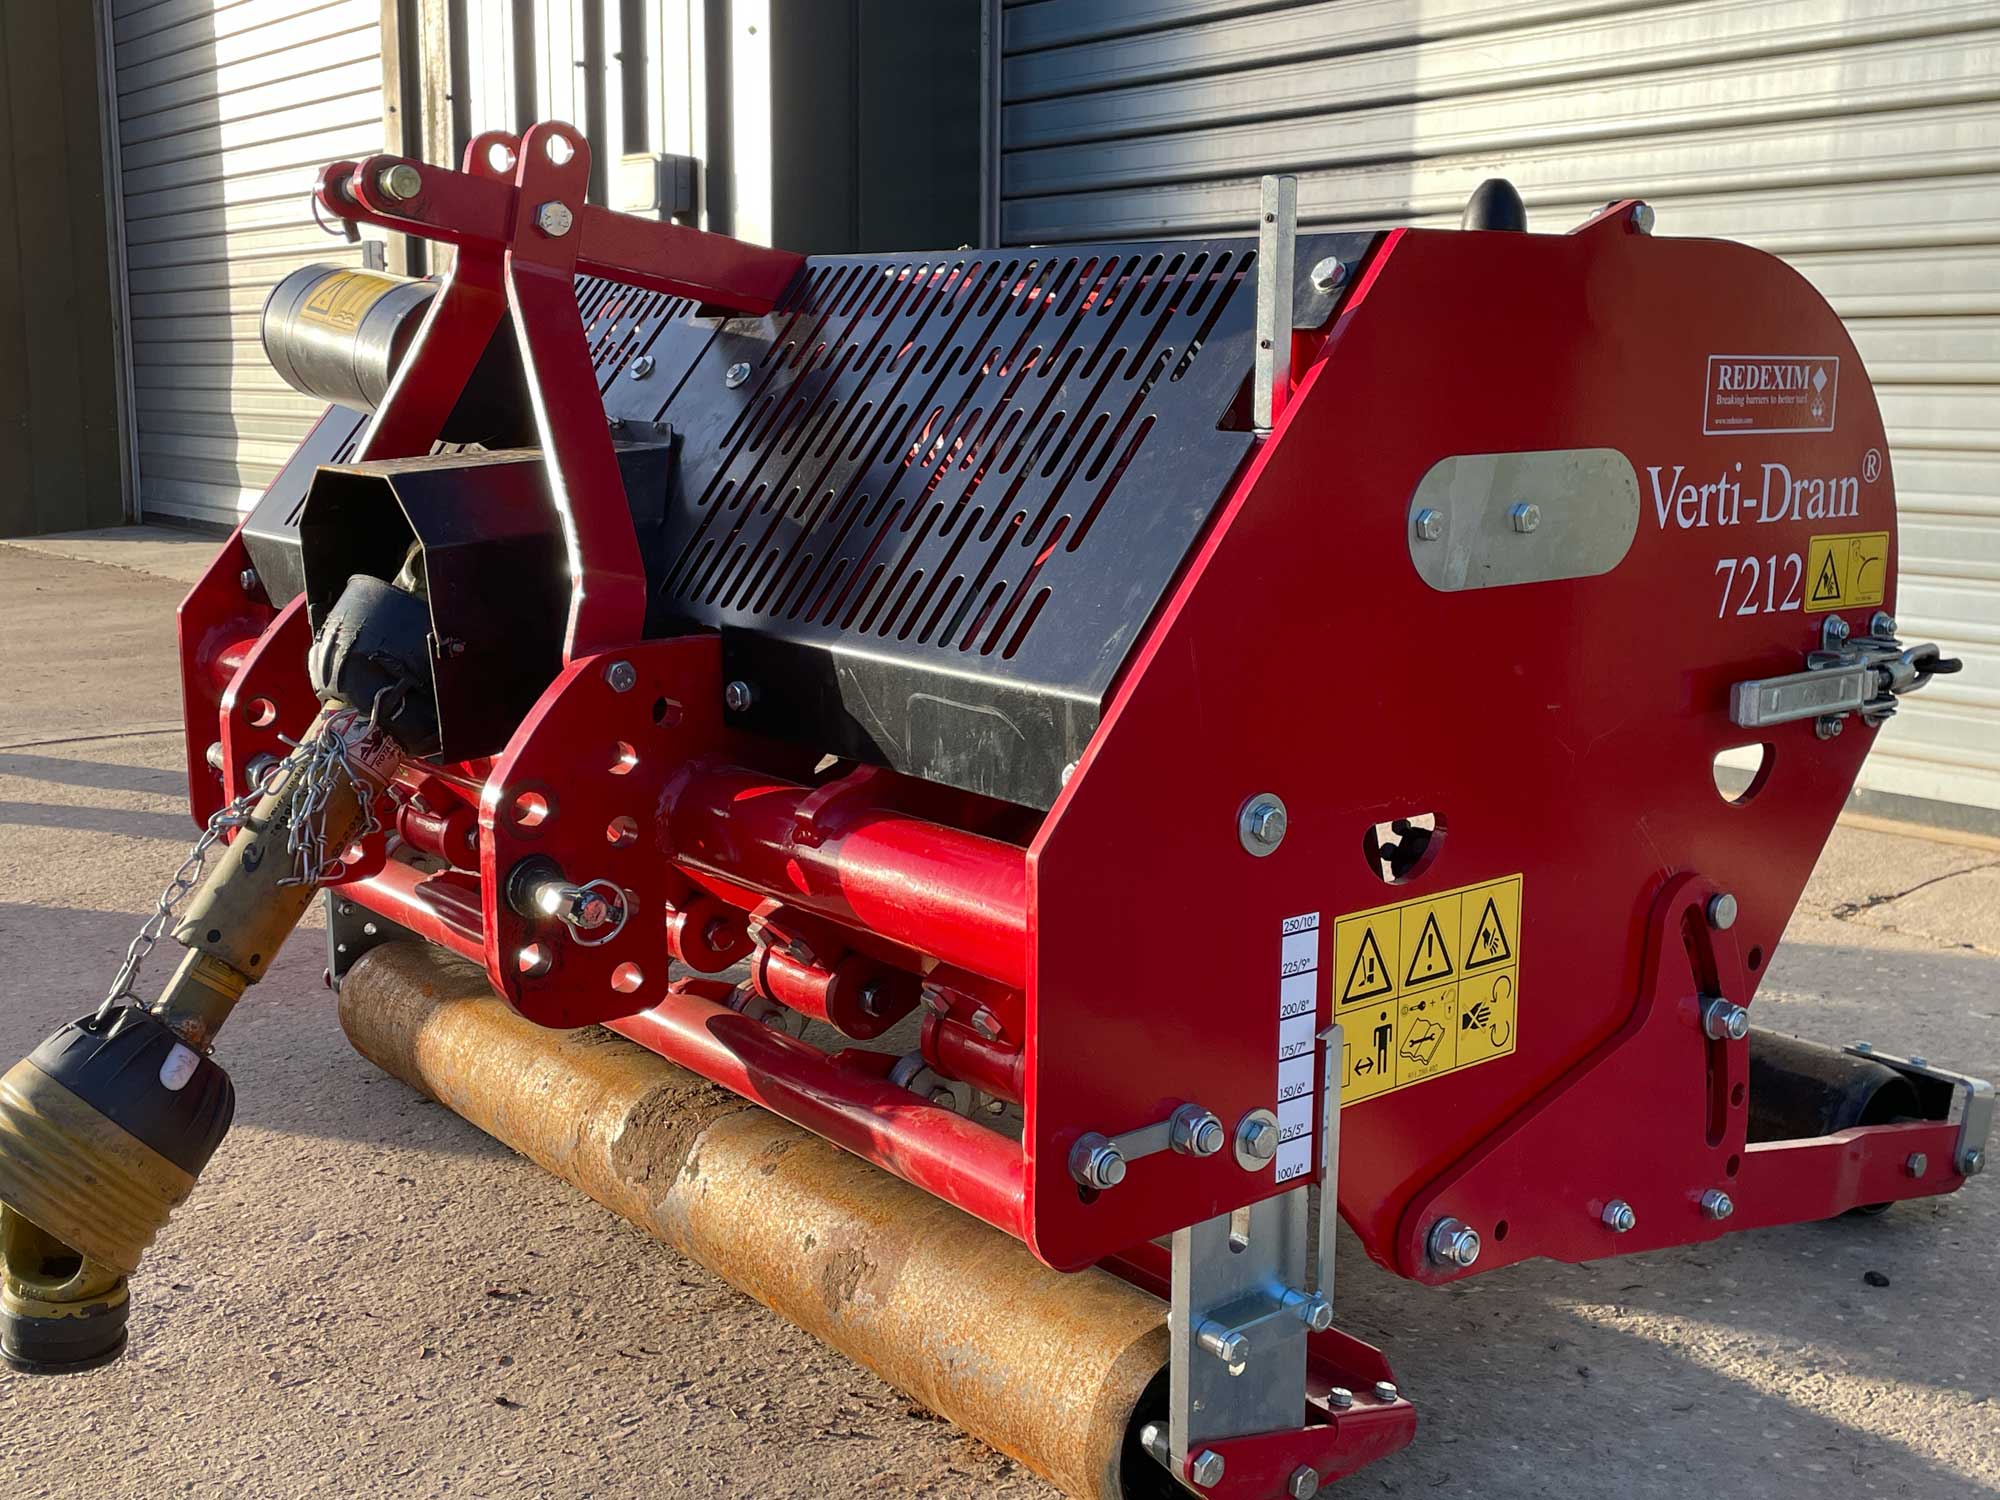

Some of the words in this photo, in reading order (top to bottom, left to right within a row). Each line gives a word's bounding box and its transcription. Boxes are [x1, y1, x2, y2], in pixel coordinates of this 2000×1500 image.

[1718, 365, 1810, 390] REDEXIM
[1716, 394, 1744, 407] Breaking
[1714, 553, 1803, 619] 7212
[1283, 915, 1316, 932] 250/10"
[1282, 958, 1310, 974] 225/9"
[1281, 1000, 1309, 1016] 200/8"
[1281, 1042, 1306, 1057] 175/7"
[1280, 1082, 1305, 1099] 150/6"
[1277, 1163, 1303, 1180] 100/4"
